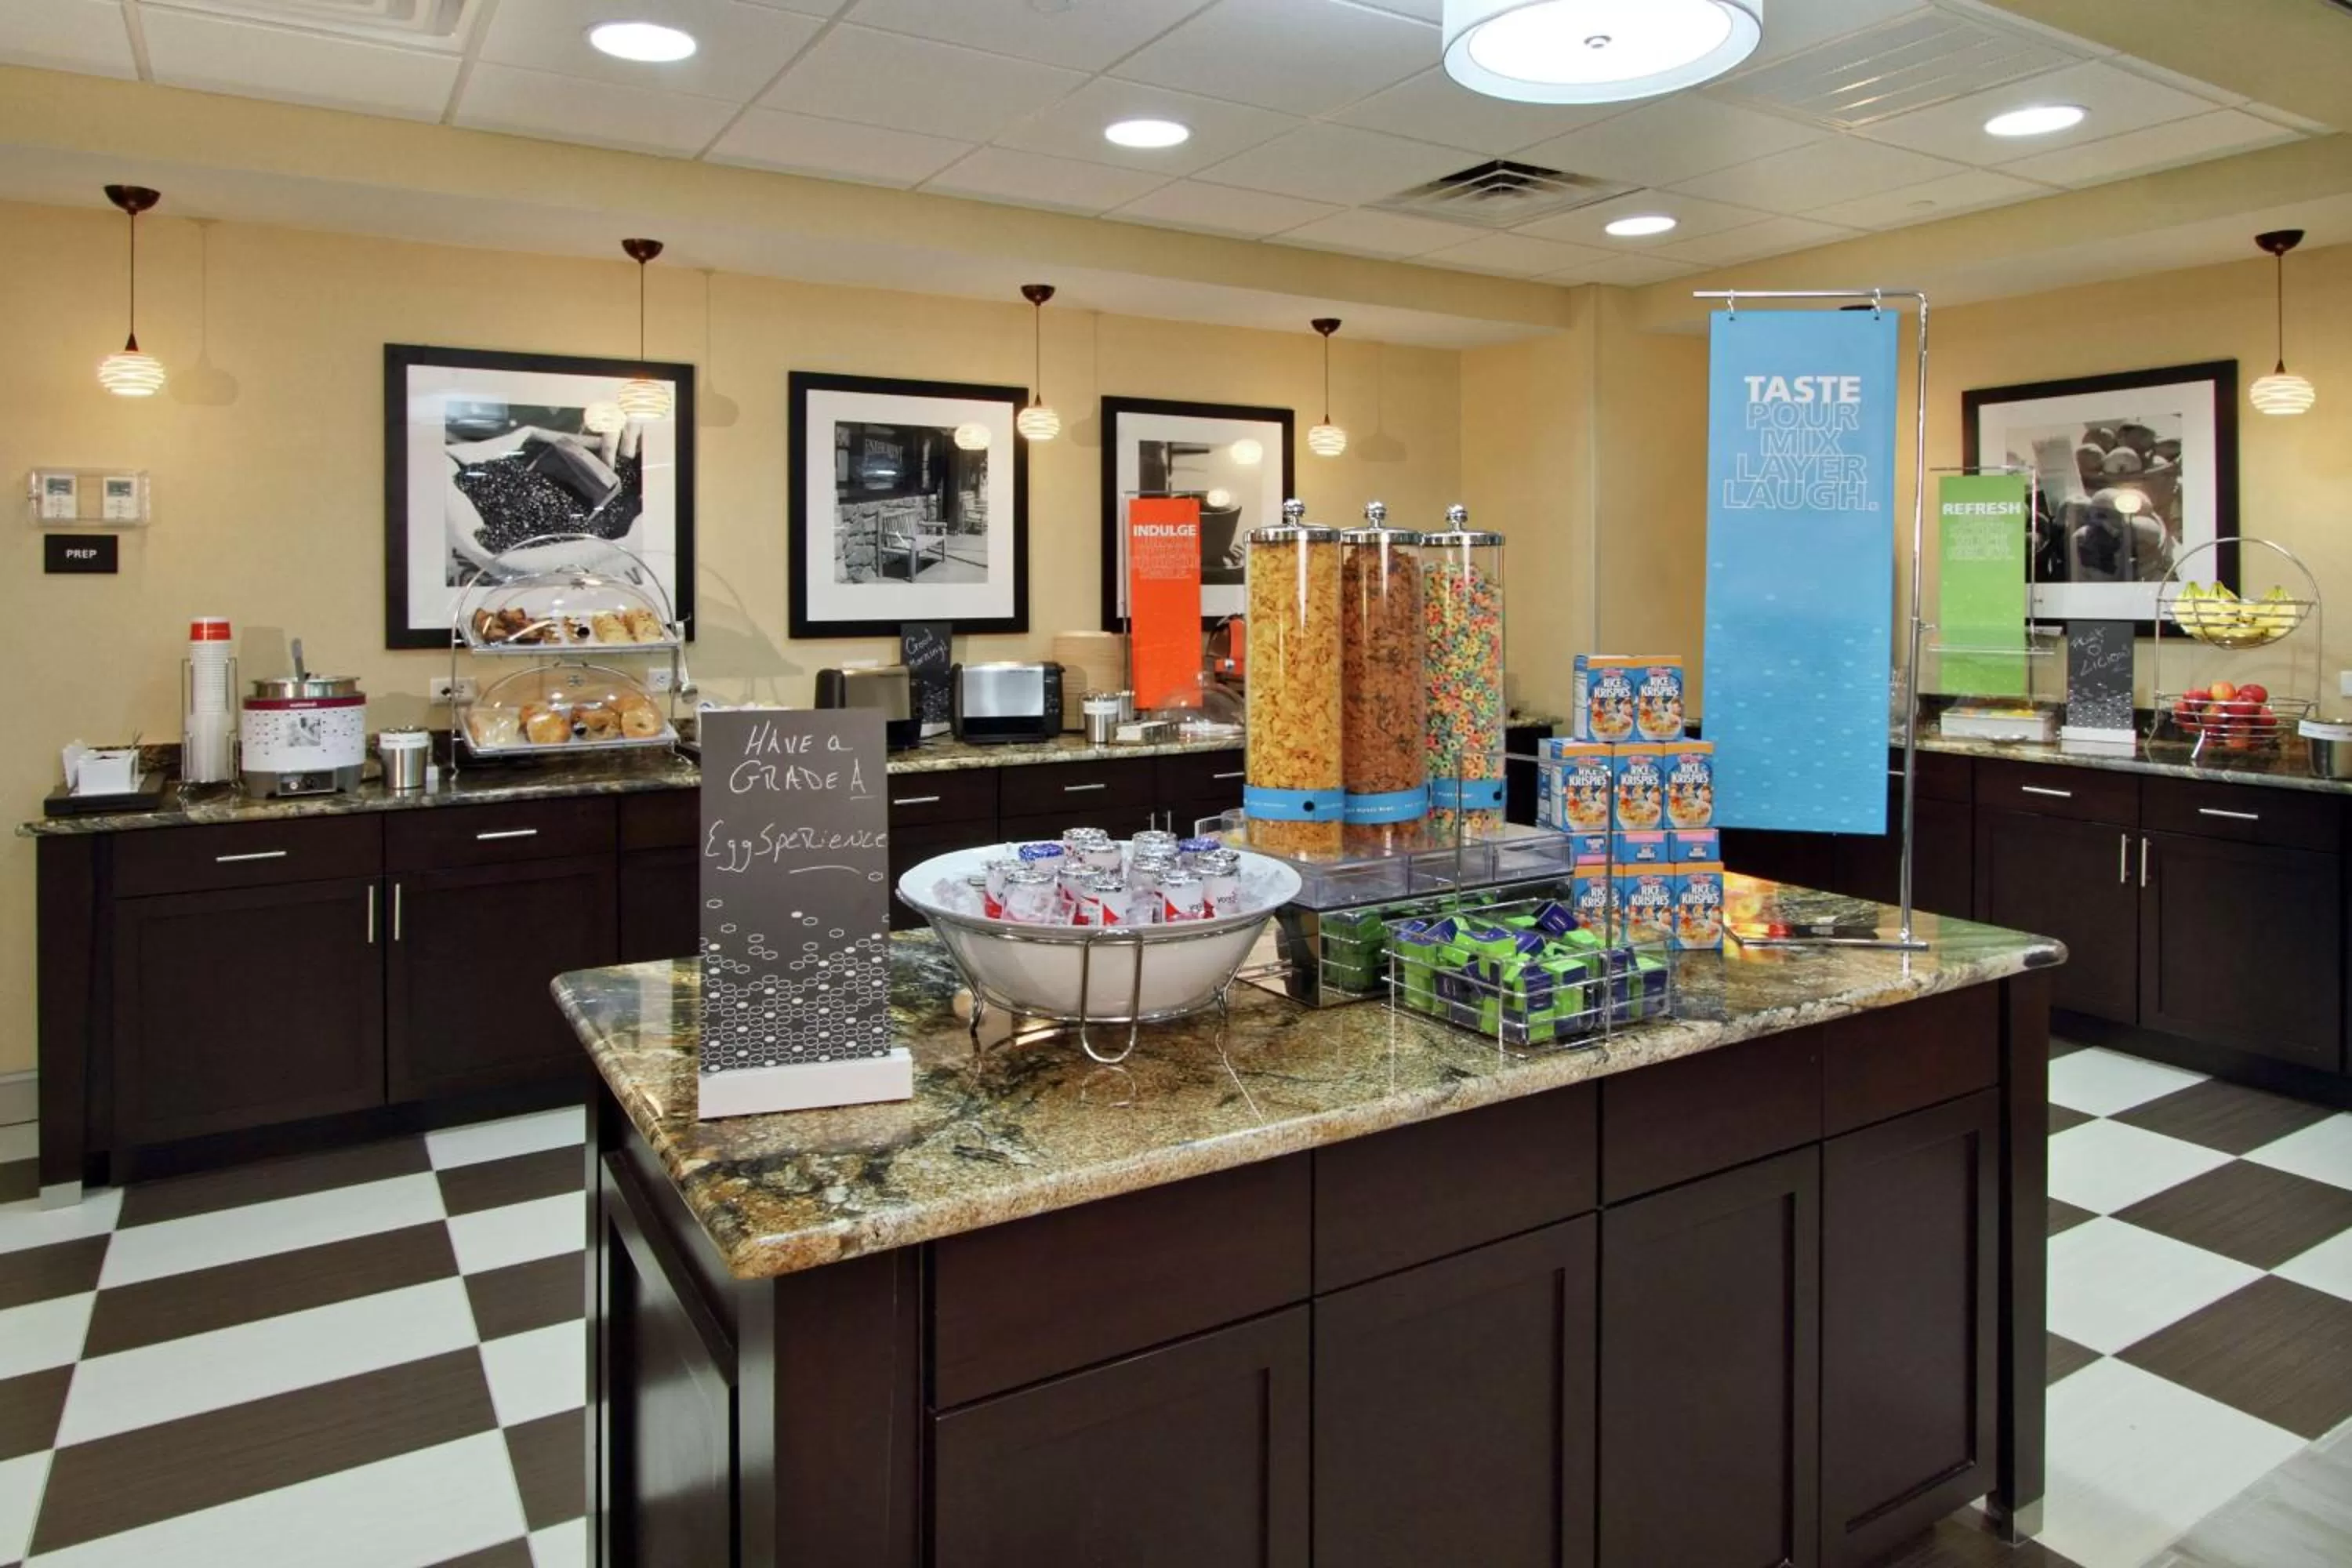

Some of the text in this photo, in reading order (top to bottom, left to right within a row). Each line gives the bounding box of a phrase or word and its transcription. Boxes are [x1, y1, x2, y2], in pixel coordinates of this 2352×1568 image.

[1744, 376, 1861, 402] TASTE
[1747, 401, 1859, 430] POUR
[1761, 427, 1842, 456] MIX
[1737, 453, 1867, 483] LAYER
[1724, 480, 1879, 510] LAUGH.
[1943, 502, 2021, 515] REFRESH
[1133, 524, 1197, 536] INDULGE
[66, 549, 97, 558] PREP
[744, 720, 814, 756] HAVE
[729, 758, 867, 794] GRADE A
